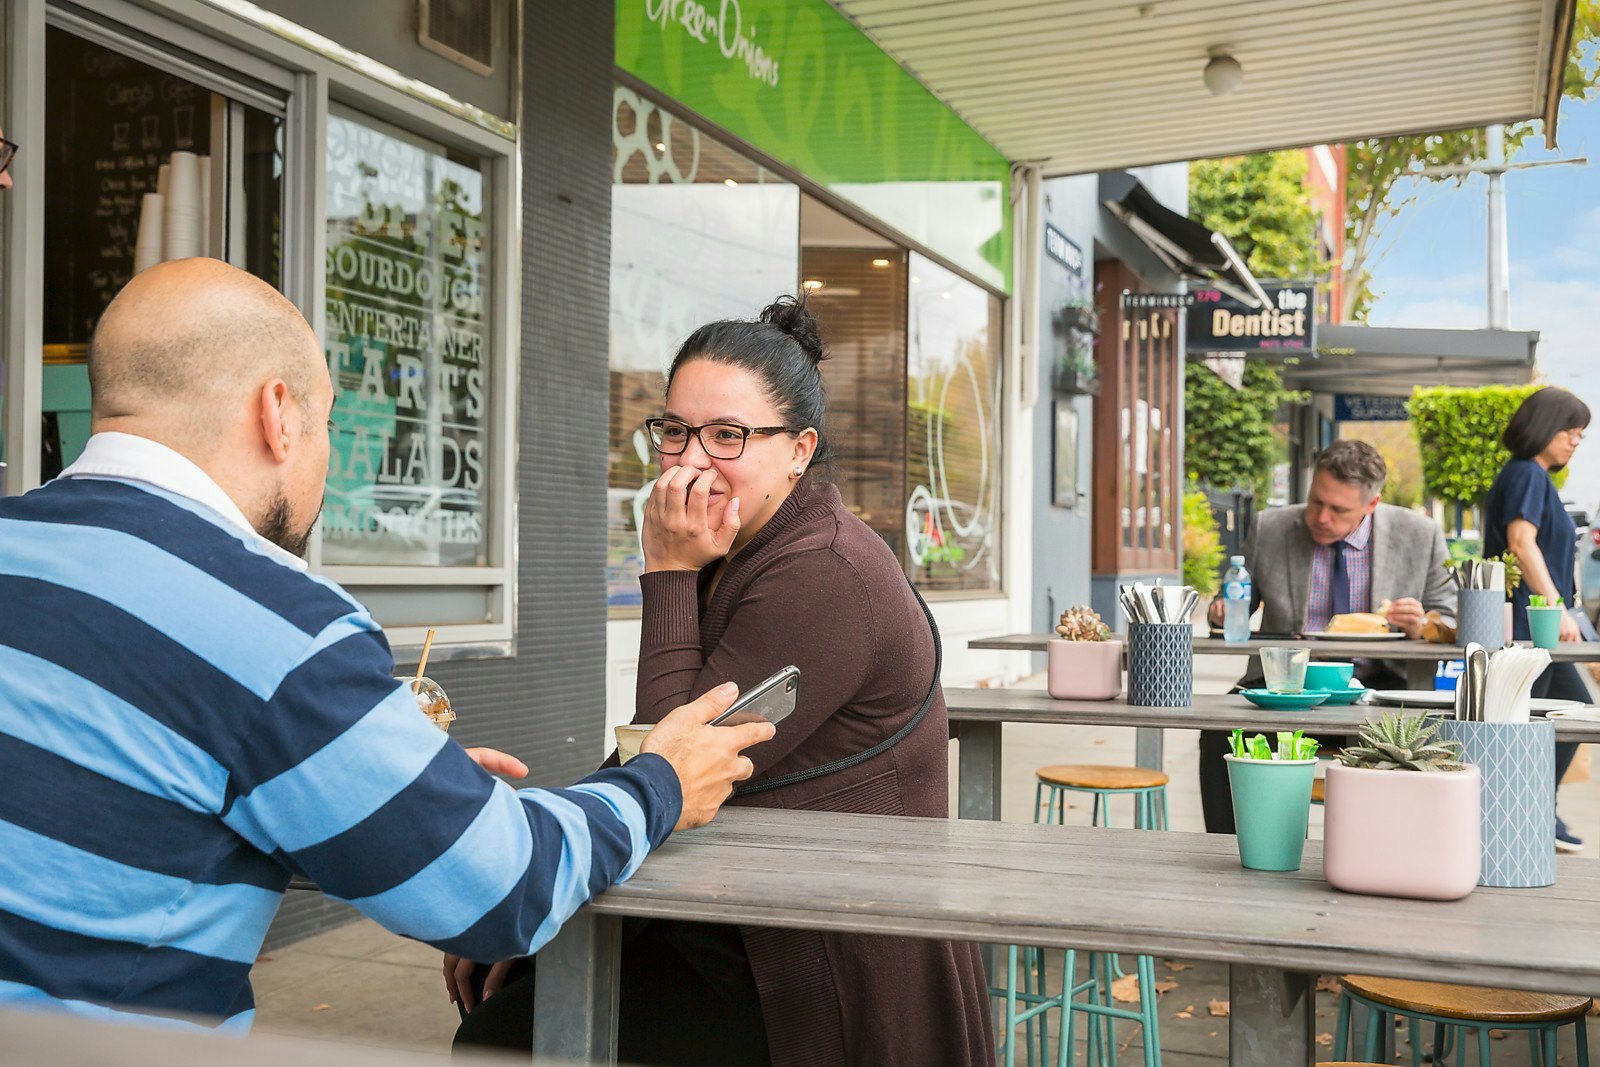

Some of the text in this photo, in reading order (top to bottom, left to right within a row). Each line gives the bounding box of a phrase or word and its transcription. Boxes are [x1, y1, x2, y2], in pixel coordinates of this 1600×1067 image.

[1212, 307, 1307, 338] Dentist
[1278, 289, 1307, 310] the
[326, 338, 484, 421] TARTS
[328, 422, 484, 491] SALADS
